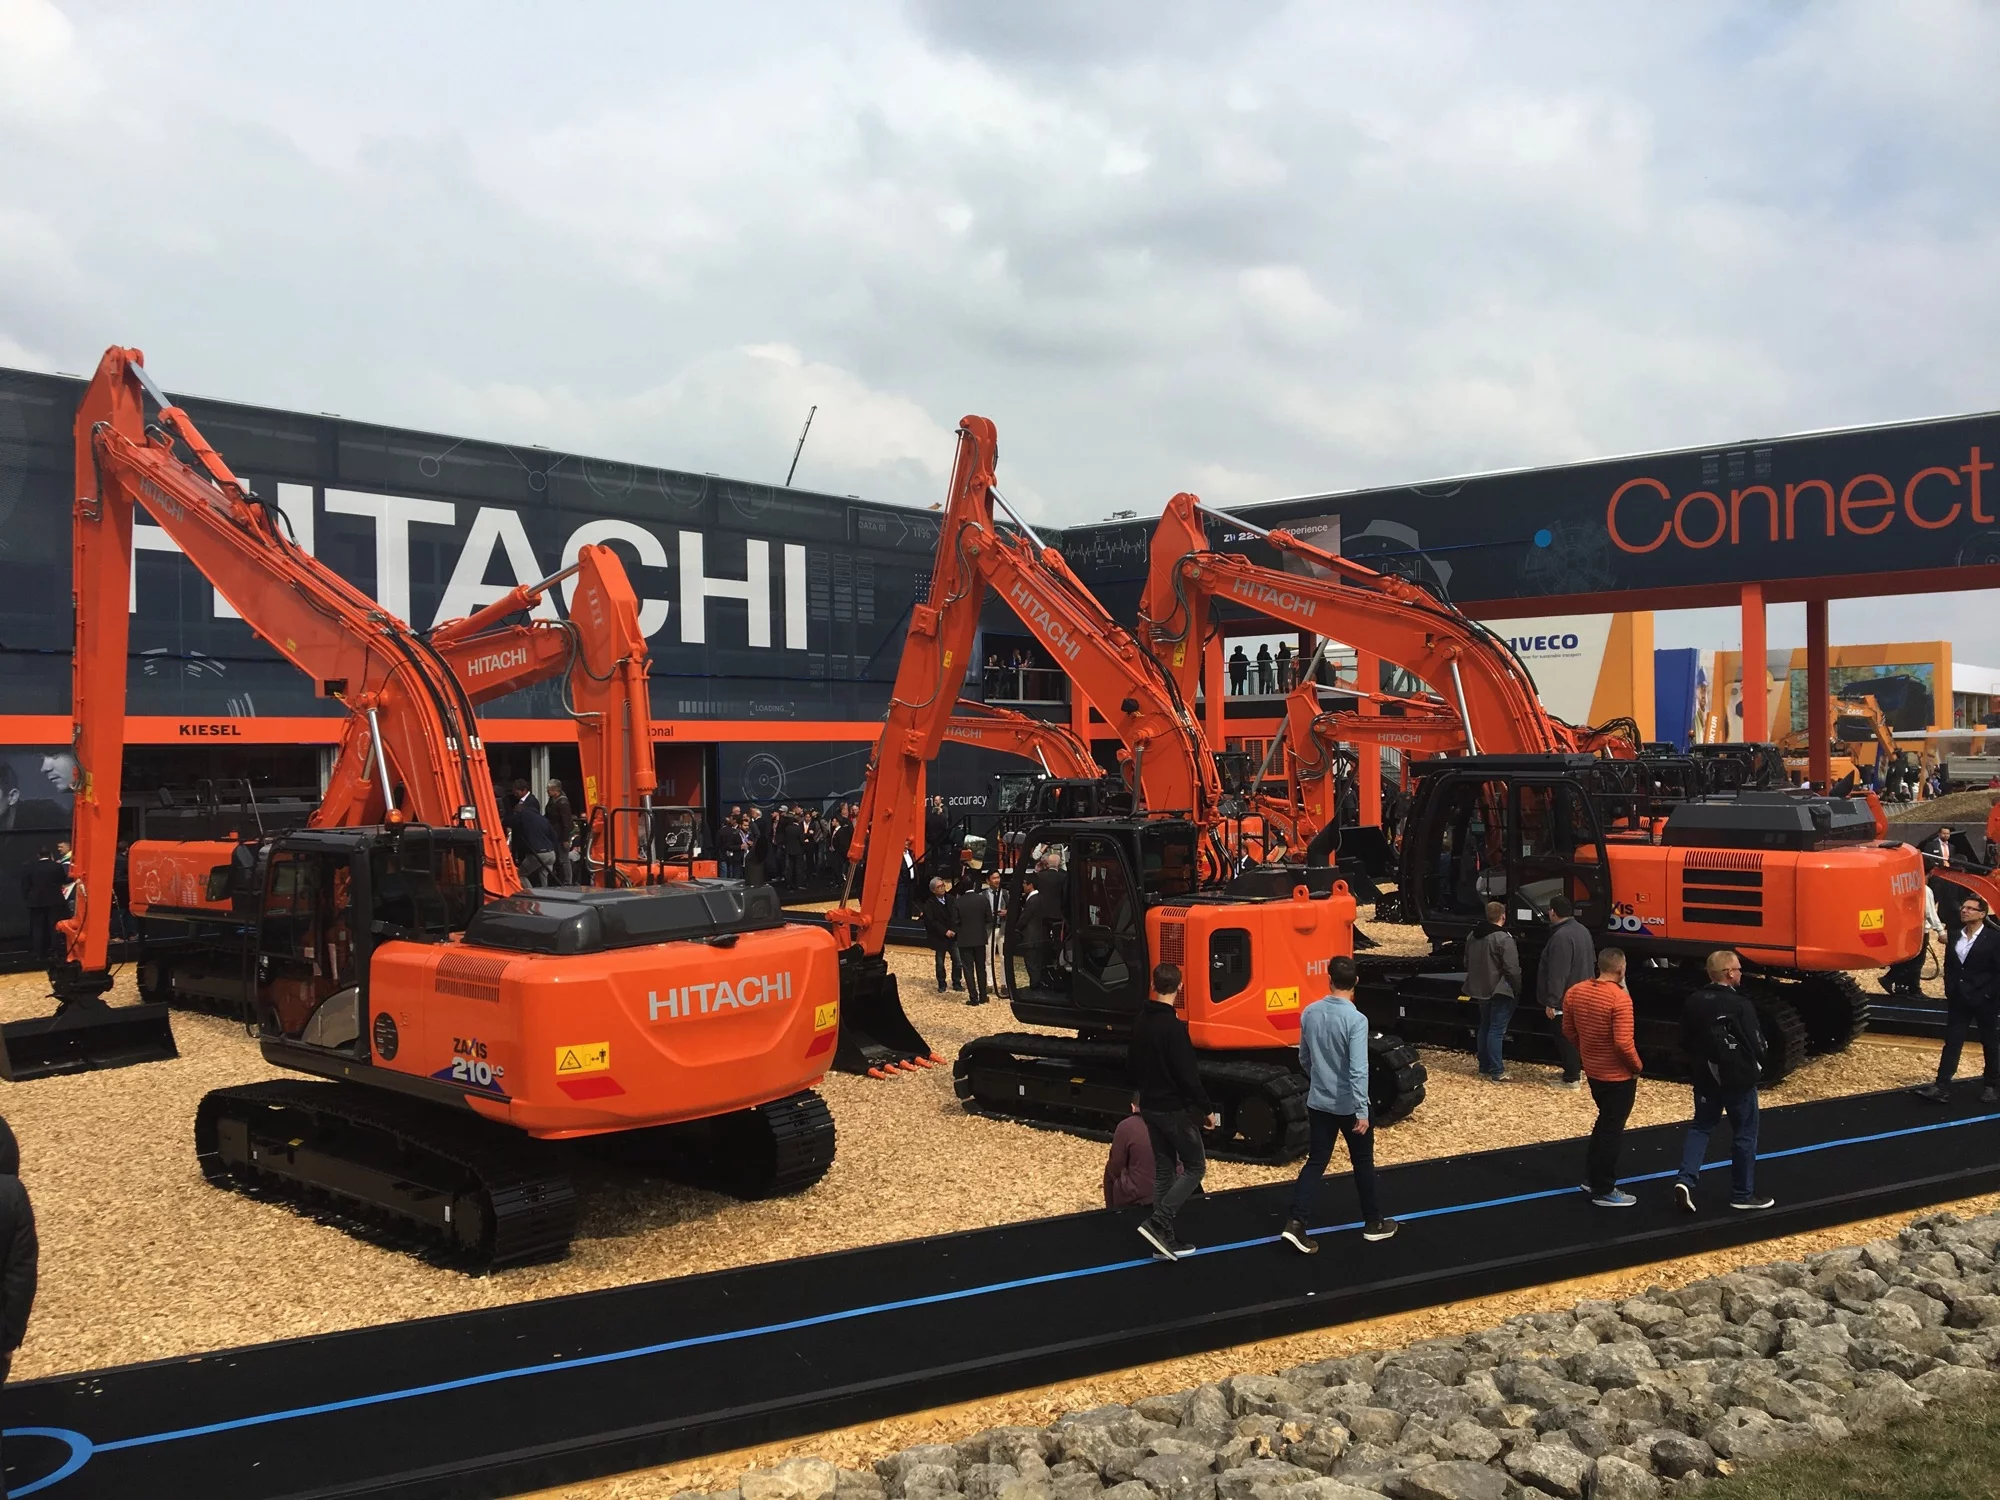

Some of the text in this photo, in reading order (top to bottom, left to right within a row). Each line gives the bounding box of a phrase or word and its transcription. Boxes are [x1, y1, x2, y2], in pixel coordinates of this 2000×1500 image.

[139, 475, 185, 522] HITACHI
[1606, 446, 1995, 554] Connect
[1232, 577, 1317, 617] HITACHI
[1010, 581, 1081, 661] HITACHI
[1507, 634, 1579, 652] IVECO
[467, 647, 527, 677] HITACHI
[1847, 708, 1865, 716] CASE
[179, 724, 242, 737] KIESEL
[945, 726, 982, 739] ITACHI
[1377, 732, 1422, 743] HITACHI
[1786, 759, 1809, 767] CASE
[948, 795, 988, 808] accuracy
[1611, 901, 1635, 916] XIS
[648, 971, 792, 1021] HITACHI
[453, 1037, 488, 1060] ZAXIS
